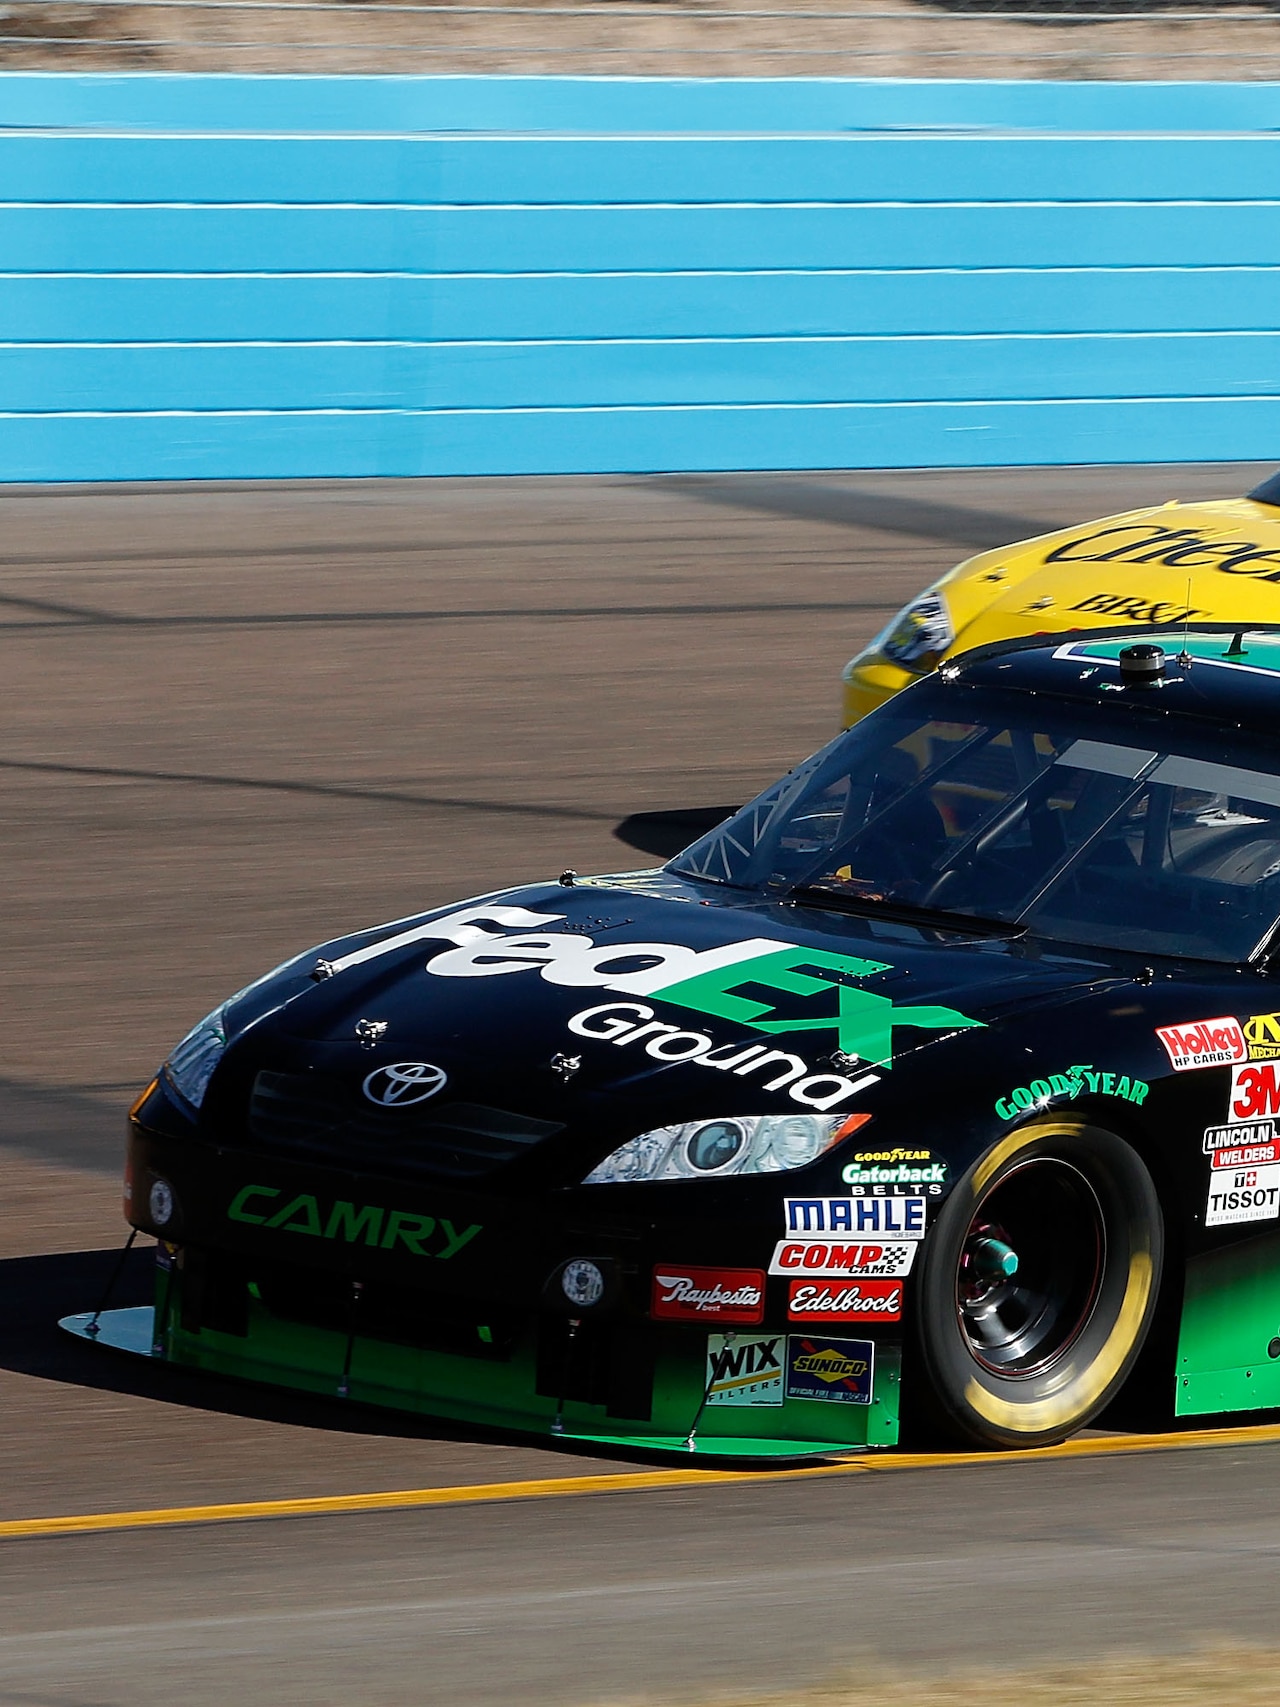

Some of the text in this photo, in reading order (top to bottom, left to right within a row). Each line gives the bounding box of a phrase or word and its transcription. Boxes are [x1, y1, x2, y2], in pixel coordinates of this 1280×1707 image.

[320, 905, 988, 1069] FedEx
[1161, 1023, 1244, 1059] Holley
[568, 1001, 880, 1110] Ground
[1174, 1051, 1233, 1067] HP CARBS
[1207, 1125, 1270, 1149] LINCOLN
[1219, 1146, 1275, 1165] WELDERS
[842, 1163, 947, 1184] Gatorback
[852, 1185, 943, 1196] BELTS
[1210, 1188, 1278, 1211] TISSOT
[227, 1184, 483, 1259] CAMRY
[788, 1199, 923, 1231] MAHLE
[778, 1244, 883, 1269] COMP
[848, 1265, 896, 1274] CAMS
[655, 1275, 762, 1311] Raybestos
[789, 1285, 900, 1313] Edelbrock
[709, 1337, 782, 1381] WIX
[796, 1357, 866, 1375] SUNOCO
[708, 1378, 781, 1402] FILTERS
